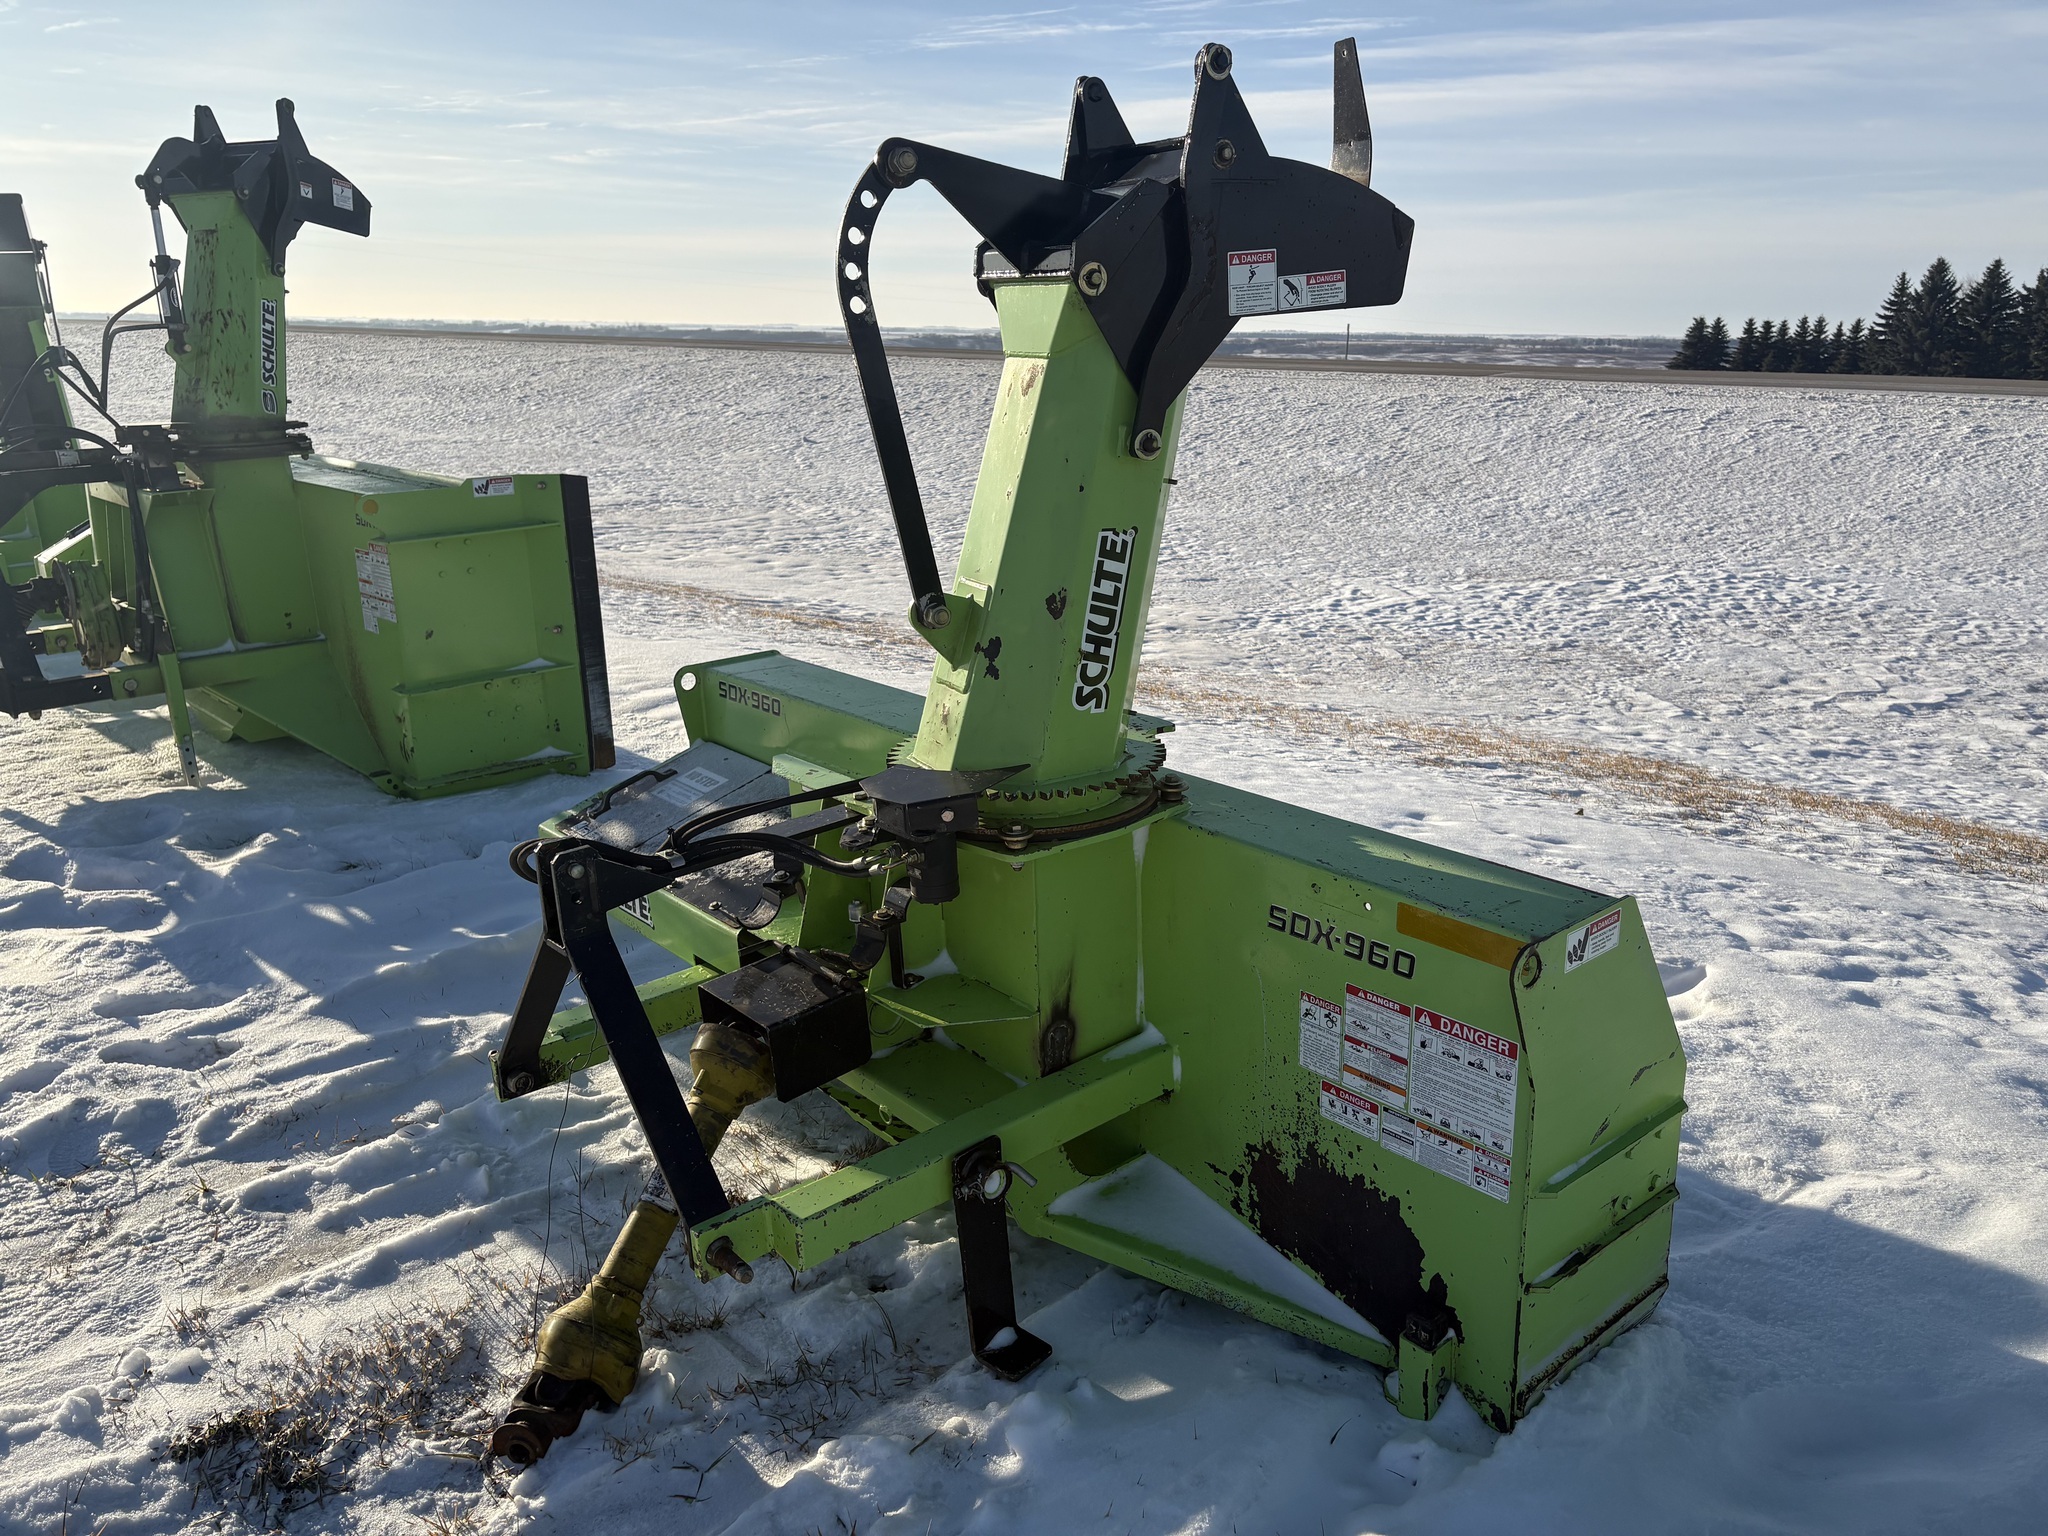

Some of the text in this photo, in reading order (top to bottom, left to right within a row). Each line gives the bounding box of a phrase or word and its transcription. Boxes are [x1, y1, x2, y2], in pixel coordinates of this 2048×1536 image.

[1241, 253, 1273, 263] DANGER
[1316, 274, 1342, 283] DANGER
[262, 300, 276, 386] SCHULTE
[1074, 534, 1130, 710] SCHULTE
[1597, 914, 1618, 930] DANGER
[1310, 996, 1341, 1015] DANGER
[1367, 993, 1400, 1012] DANGER
[1440, 1018, 1511, 1056] DANGER
[1367, 1044, 1391, 1059] PELIGRO
[1363, 1074, 1391, 1090] WARNING
[1339, 1091, 1371, 1111] DANGER
[1432, 1127, 1464, 1146] WARNING
[1485, 1150, 1508, 1164] DANGER
[1484, 1170, 1505, 1184] PELIGRO
